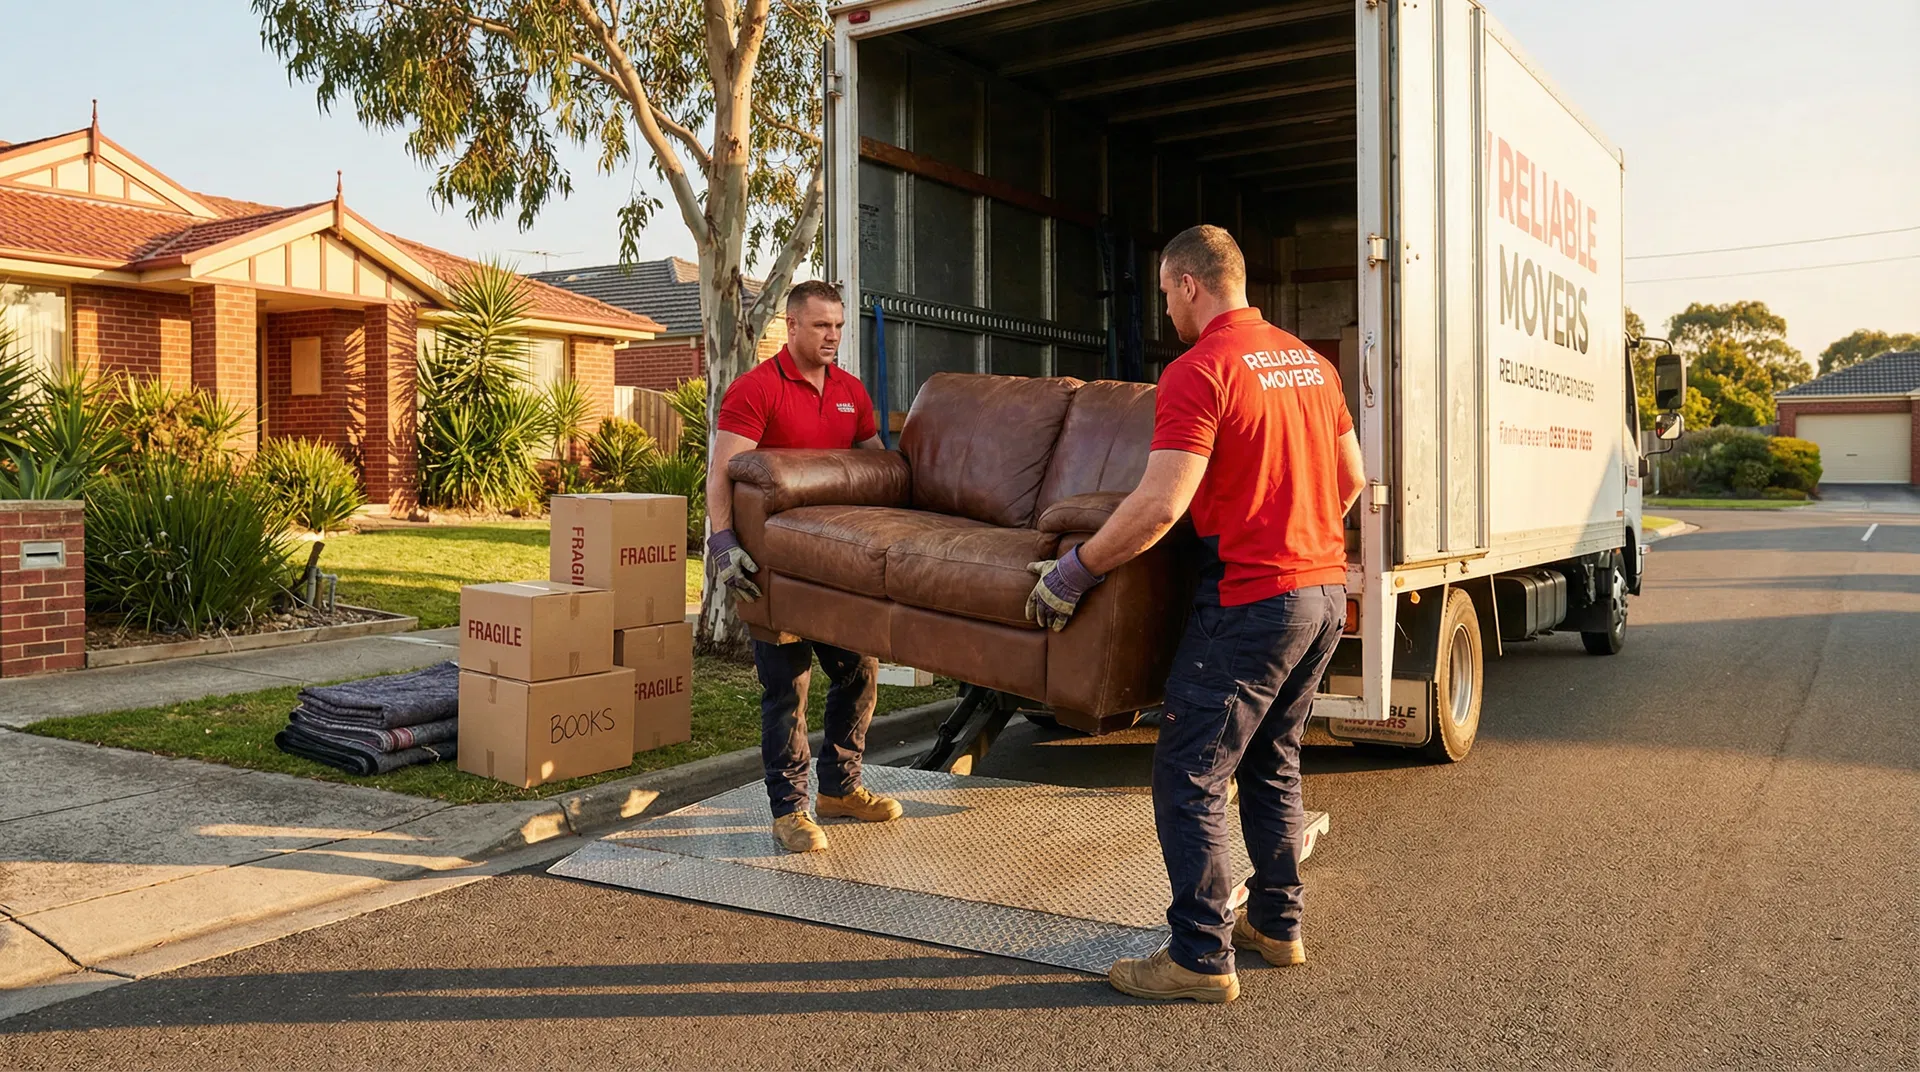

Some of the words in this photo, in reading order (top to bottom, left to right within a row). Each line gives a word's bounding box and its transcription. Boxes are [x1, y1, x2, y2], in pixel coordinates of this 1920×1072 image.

[1498, 136, 1597, 274] RELIABLE
[1499, 243, 1589, 355] MOVERS
[1241, 349, 1320, 371] RELIABLE
[1257, 367, 1325, 391] MOVERS
[620, 544, 677, 566] FRAGILE
[468, 619, 522, 647] FRAGILE
[550, 707, 615, 744] BOOKS
